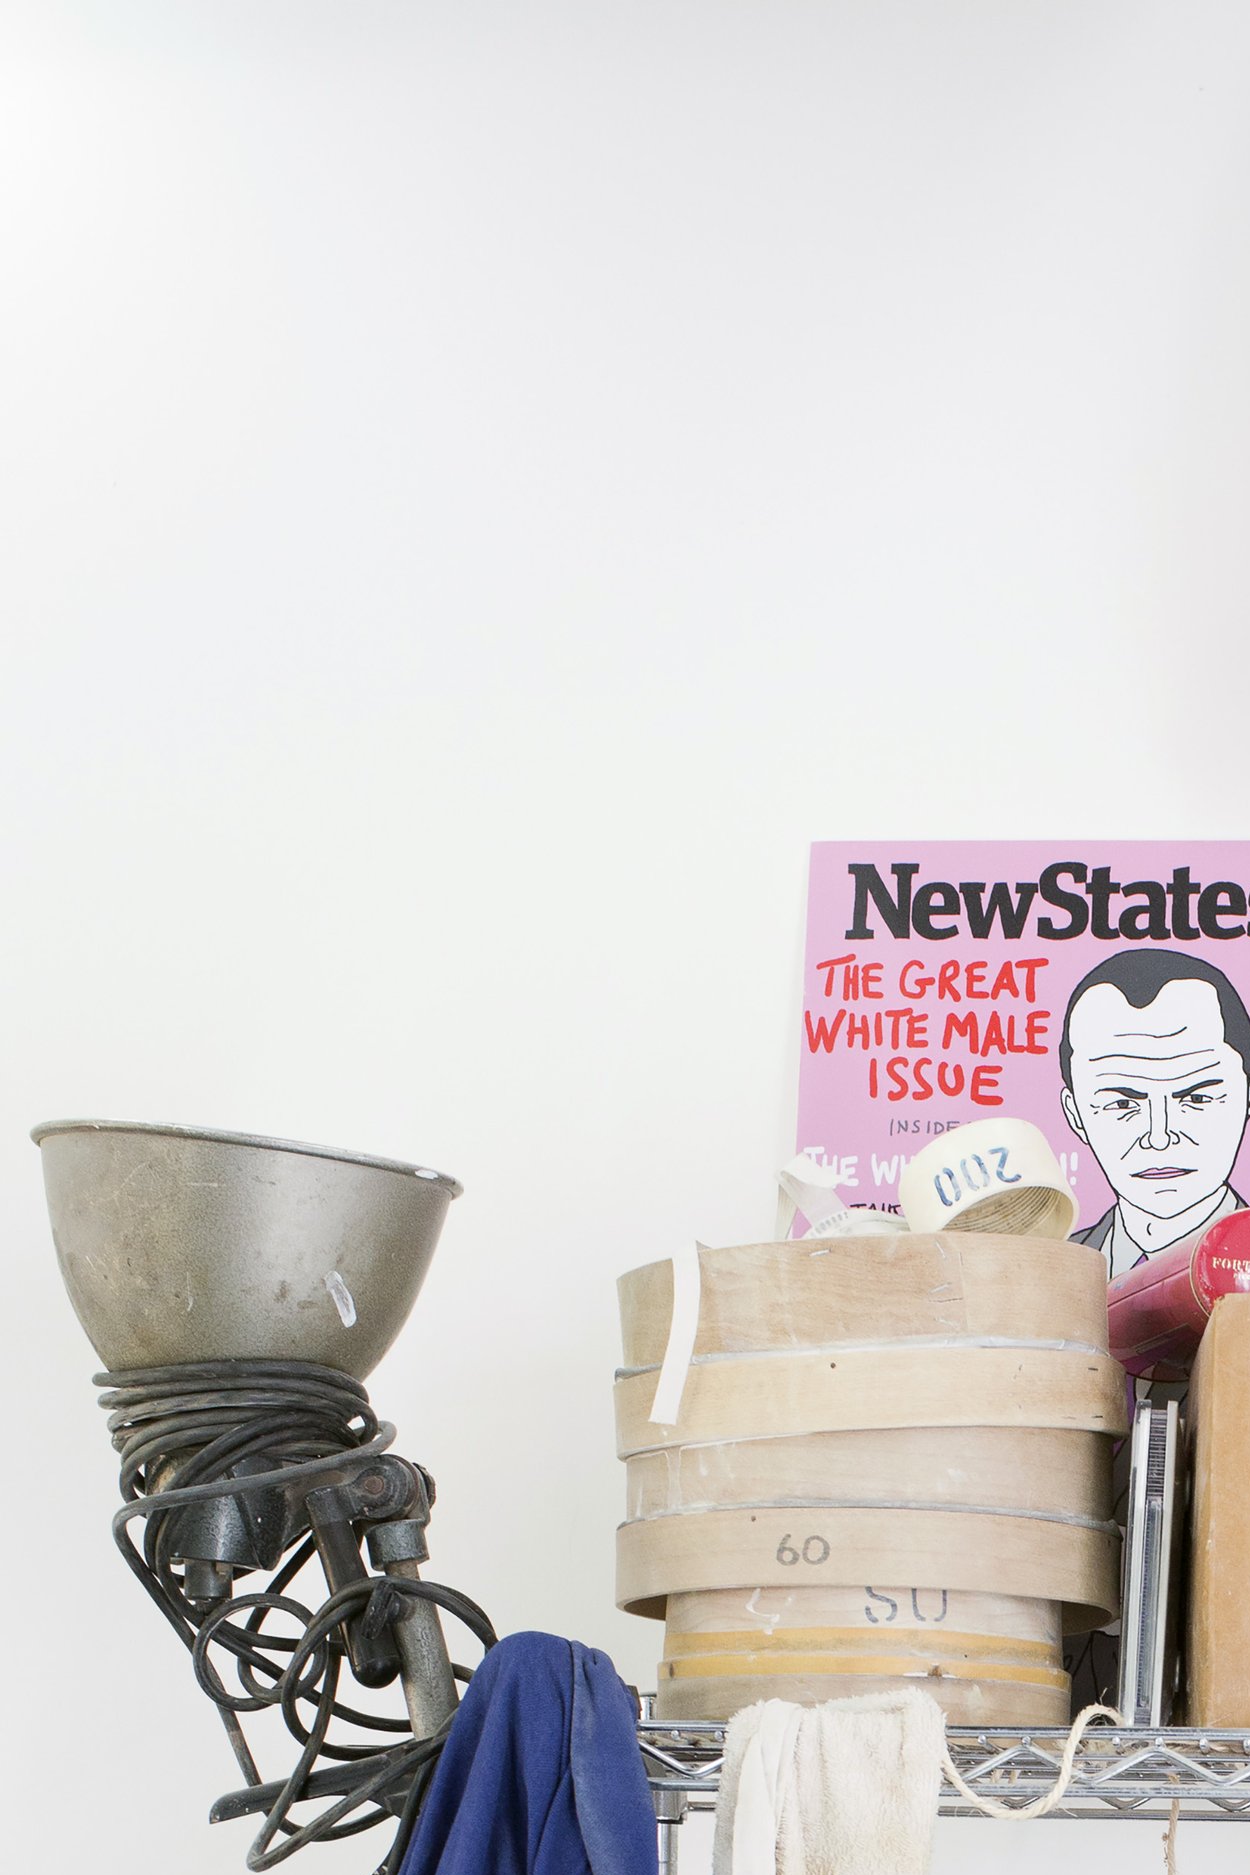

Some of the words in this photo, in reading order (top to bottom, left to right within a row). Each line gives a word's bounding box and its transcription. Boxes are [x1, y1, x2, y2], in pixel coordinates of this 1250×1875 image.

[816, 954, 884, 1000] THE
[900, 958, 1049, 1003] GREAT
[805, 1008, 929, 1054] WHITE
[942, 1011, 1051, 1057] MALE
[869, 1057, 1004, 1106] ISSUE
[776, 1533, 831, 1566] 60
